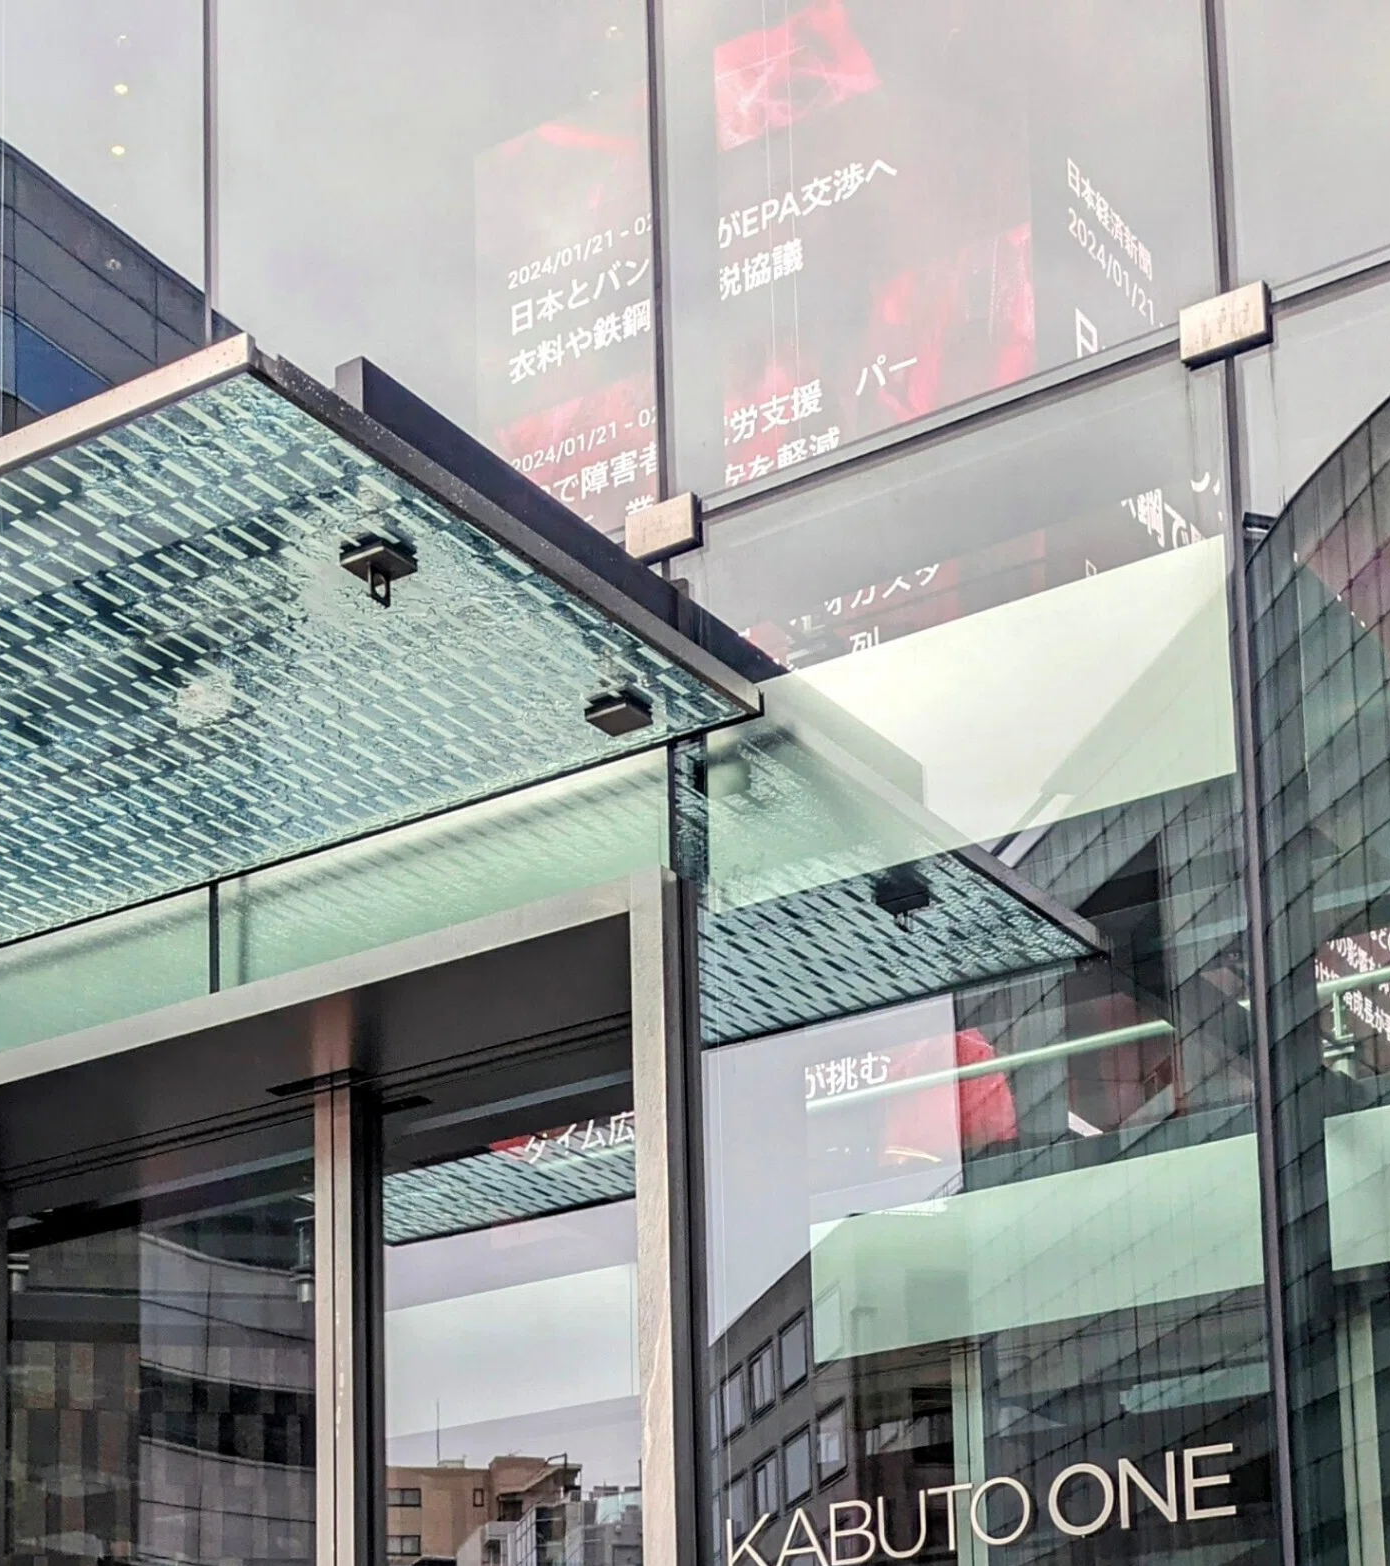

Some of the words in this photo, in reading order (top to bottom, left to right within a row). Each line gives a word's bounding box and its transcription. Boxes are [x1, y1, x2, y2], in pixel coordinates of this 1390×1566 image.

[507, 229, 613, 290] 2024/01/21
[510, 258, 650, 336] 日本とバン
[509, 299, 651, 385] 衣料や鉄鋼
[724, 379, 823, 448] 労支援
[539, 441, 658, 502] で障害者
[1047, 1442, 1238, 1538] ONE
